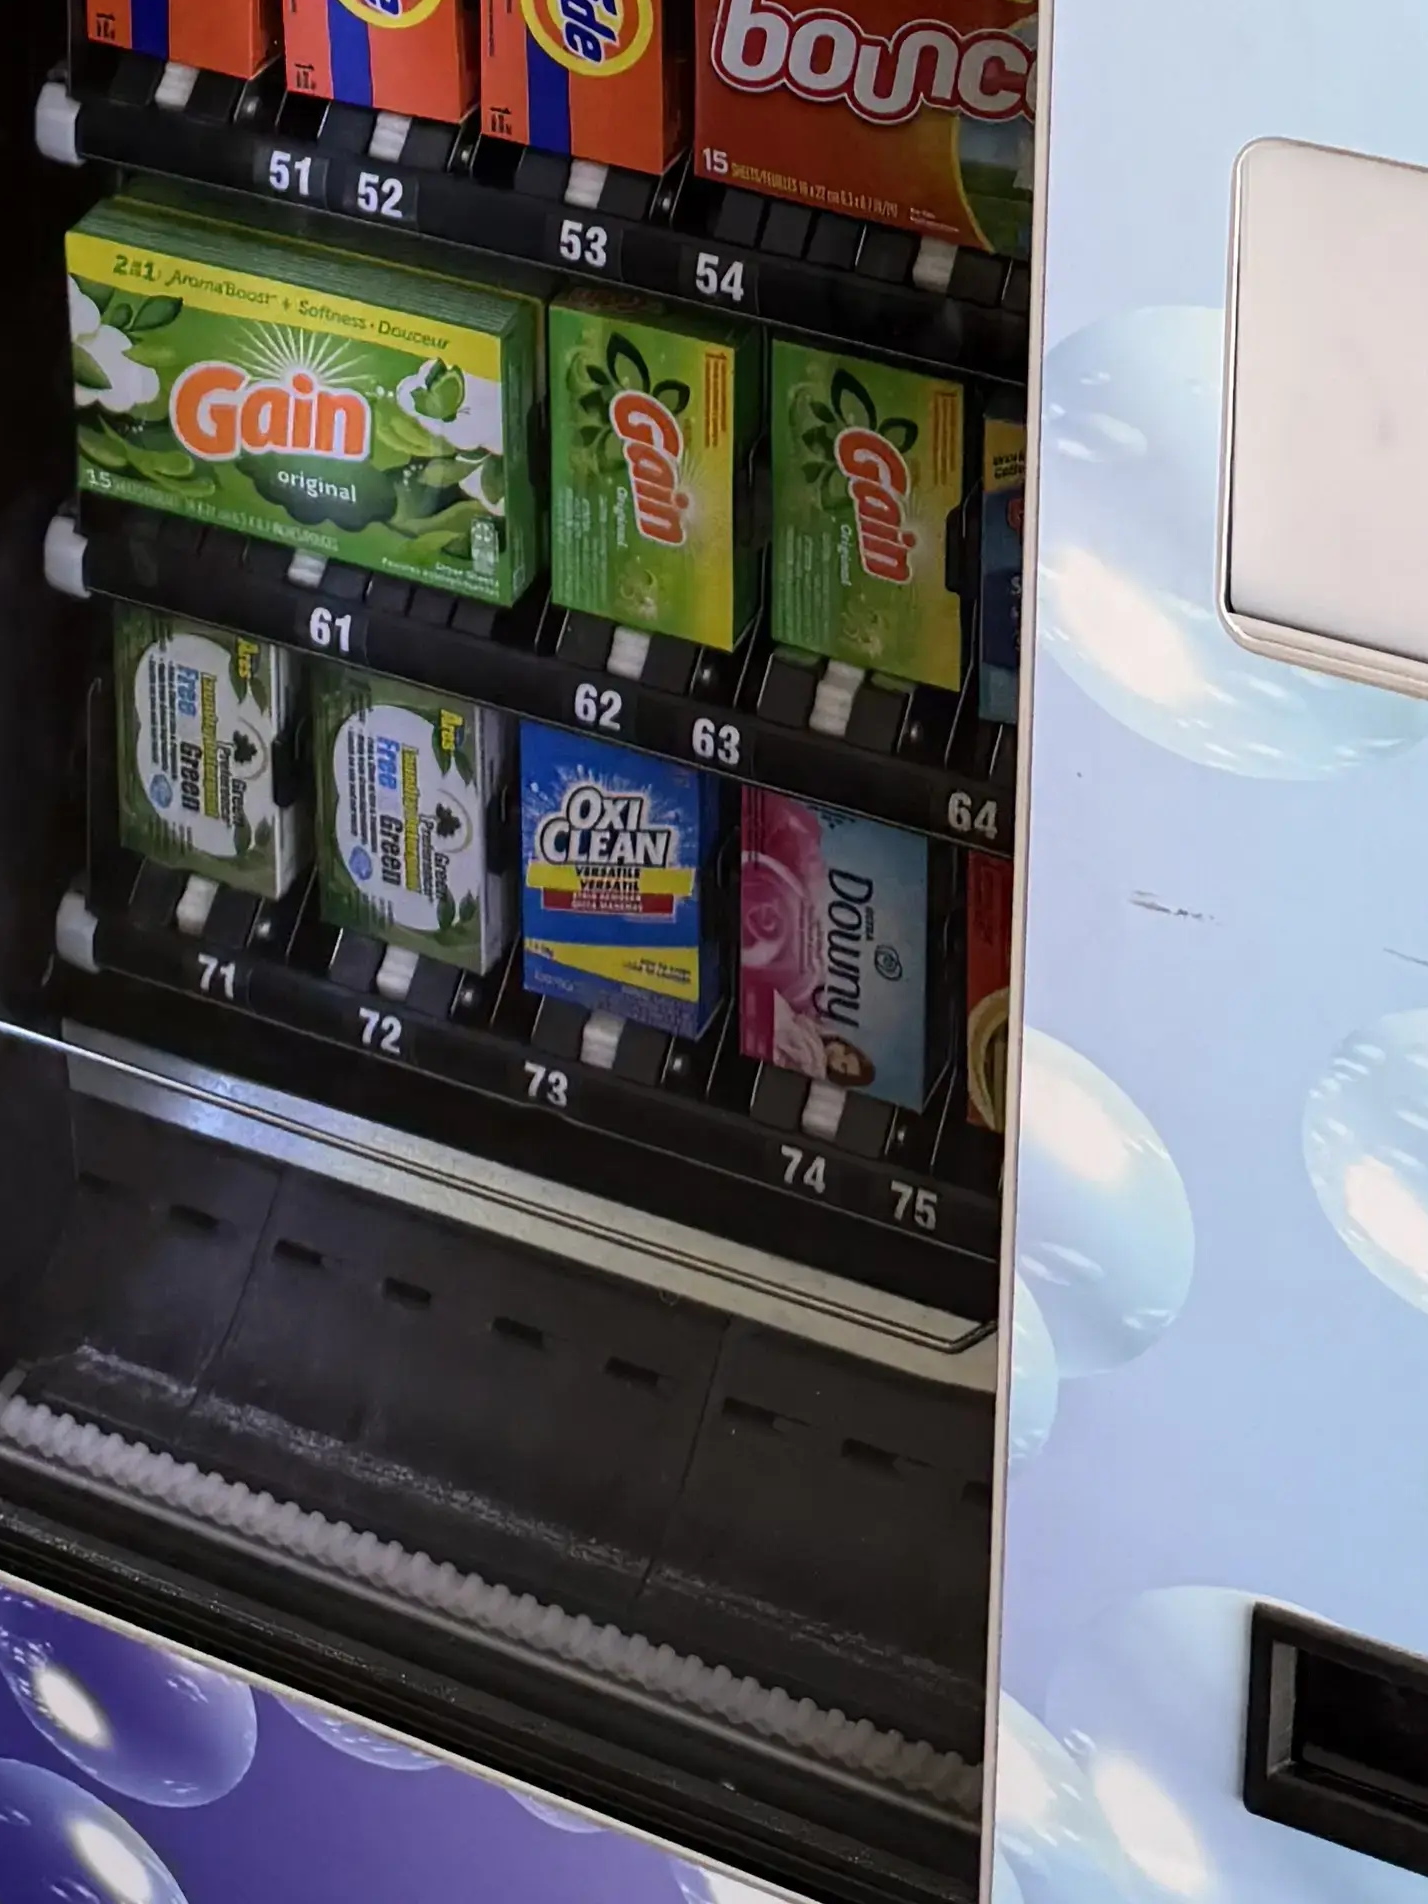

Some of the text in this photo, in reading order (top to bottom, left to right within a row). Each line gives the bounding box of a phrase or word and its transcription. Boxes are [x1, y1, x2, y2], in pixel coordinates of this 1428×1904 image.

[269, 150, 311, 196] 51
[703, 148, 728, 174] 15
[357, 171, 403, 218] 52
[560, 221, 607, 268] 53
[696, 253, 744, 301] 54
[298, 298, 450, 350] Softness Douceur
[170, 361, 370, 461] Gain
[85, 468, 112, 489] 15
[278, 468, 357, 504] original
[610, 389, 688, 546] Gain
[835, 426, 915, 584] Gain
[309, 607, 352, 652] 61
[440, 709, 464, 751] Ares
[574, 684, 622, 731] 62
[176, 663, 203, 812] Free Green
[692, 717, 741, 765] 63
[377, 735, 404, 886] Free Green
[569, 786, 642, 832] OXI
[948, 792, 997, 838] 64
[540, 819, 673, 868] CLEAN
[575, 866, 641, 878] VERSATILE
[580, 879, 639, 891] VERSATIL
[812, 868, 874, 1028] Downy
[198, 954, 235, 999] 71
[359, 1008, 401, 1054] 72
[524, 1063, 568, 1108] 73
[780, 1145, 827, 1193] 74
[890, 1181, 939, 1231] 75
